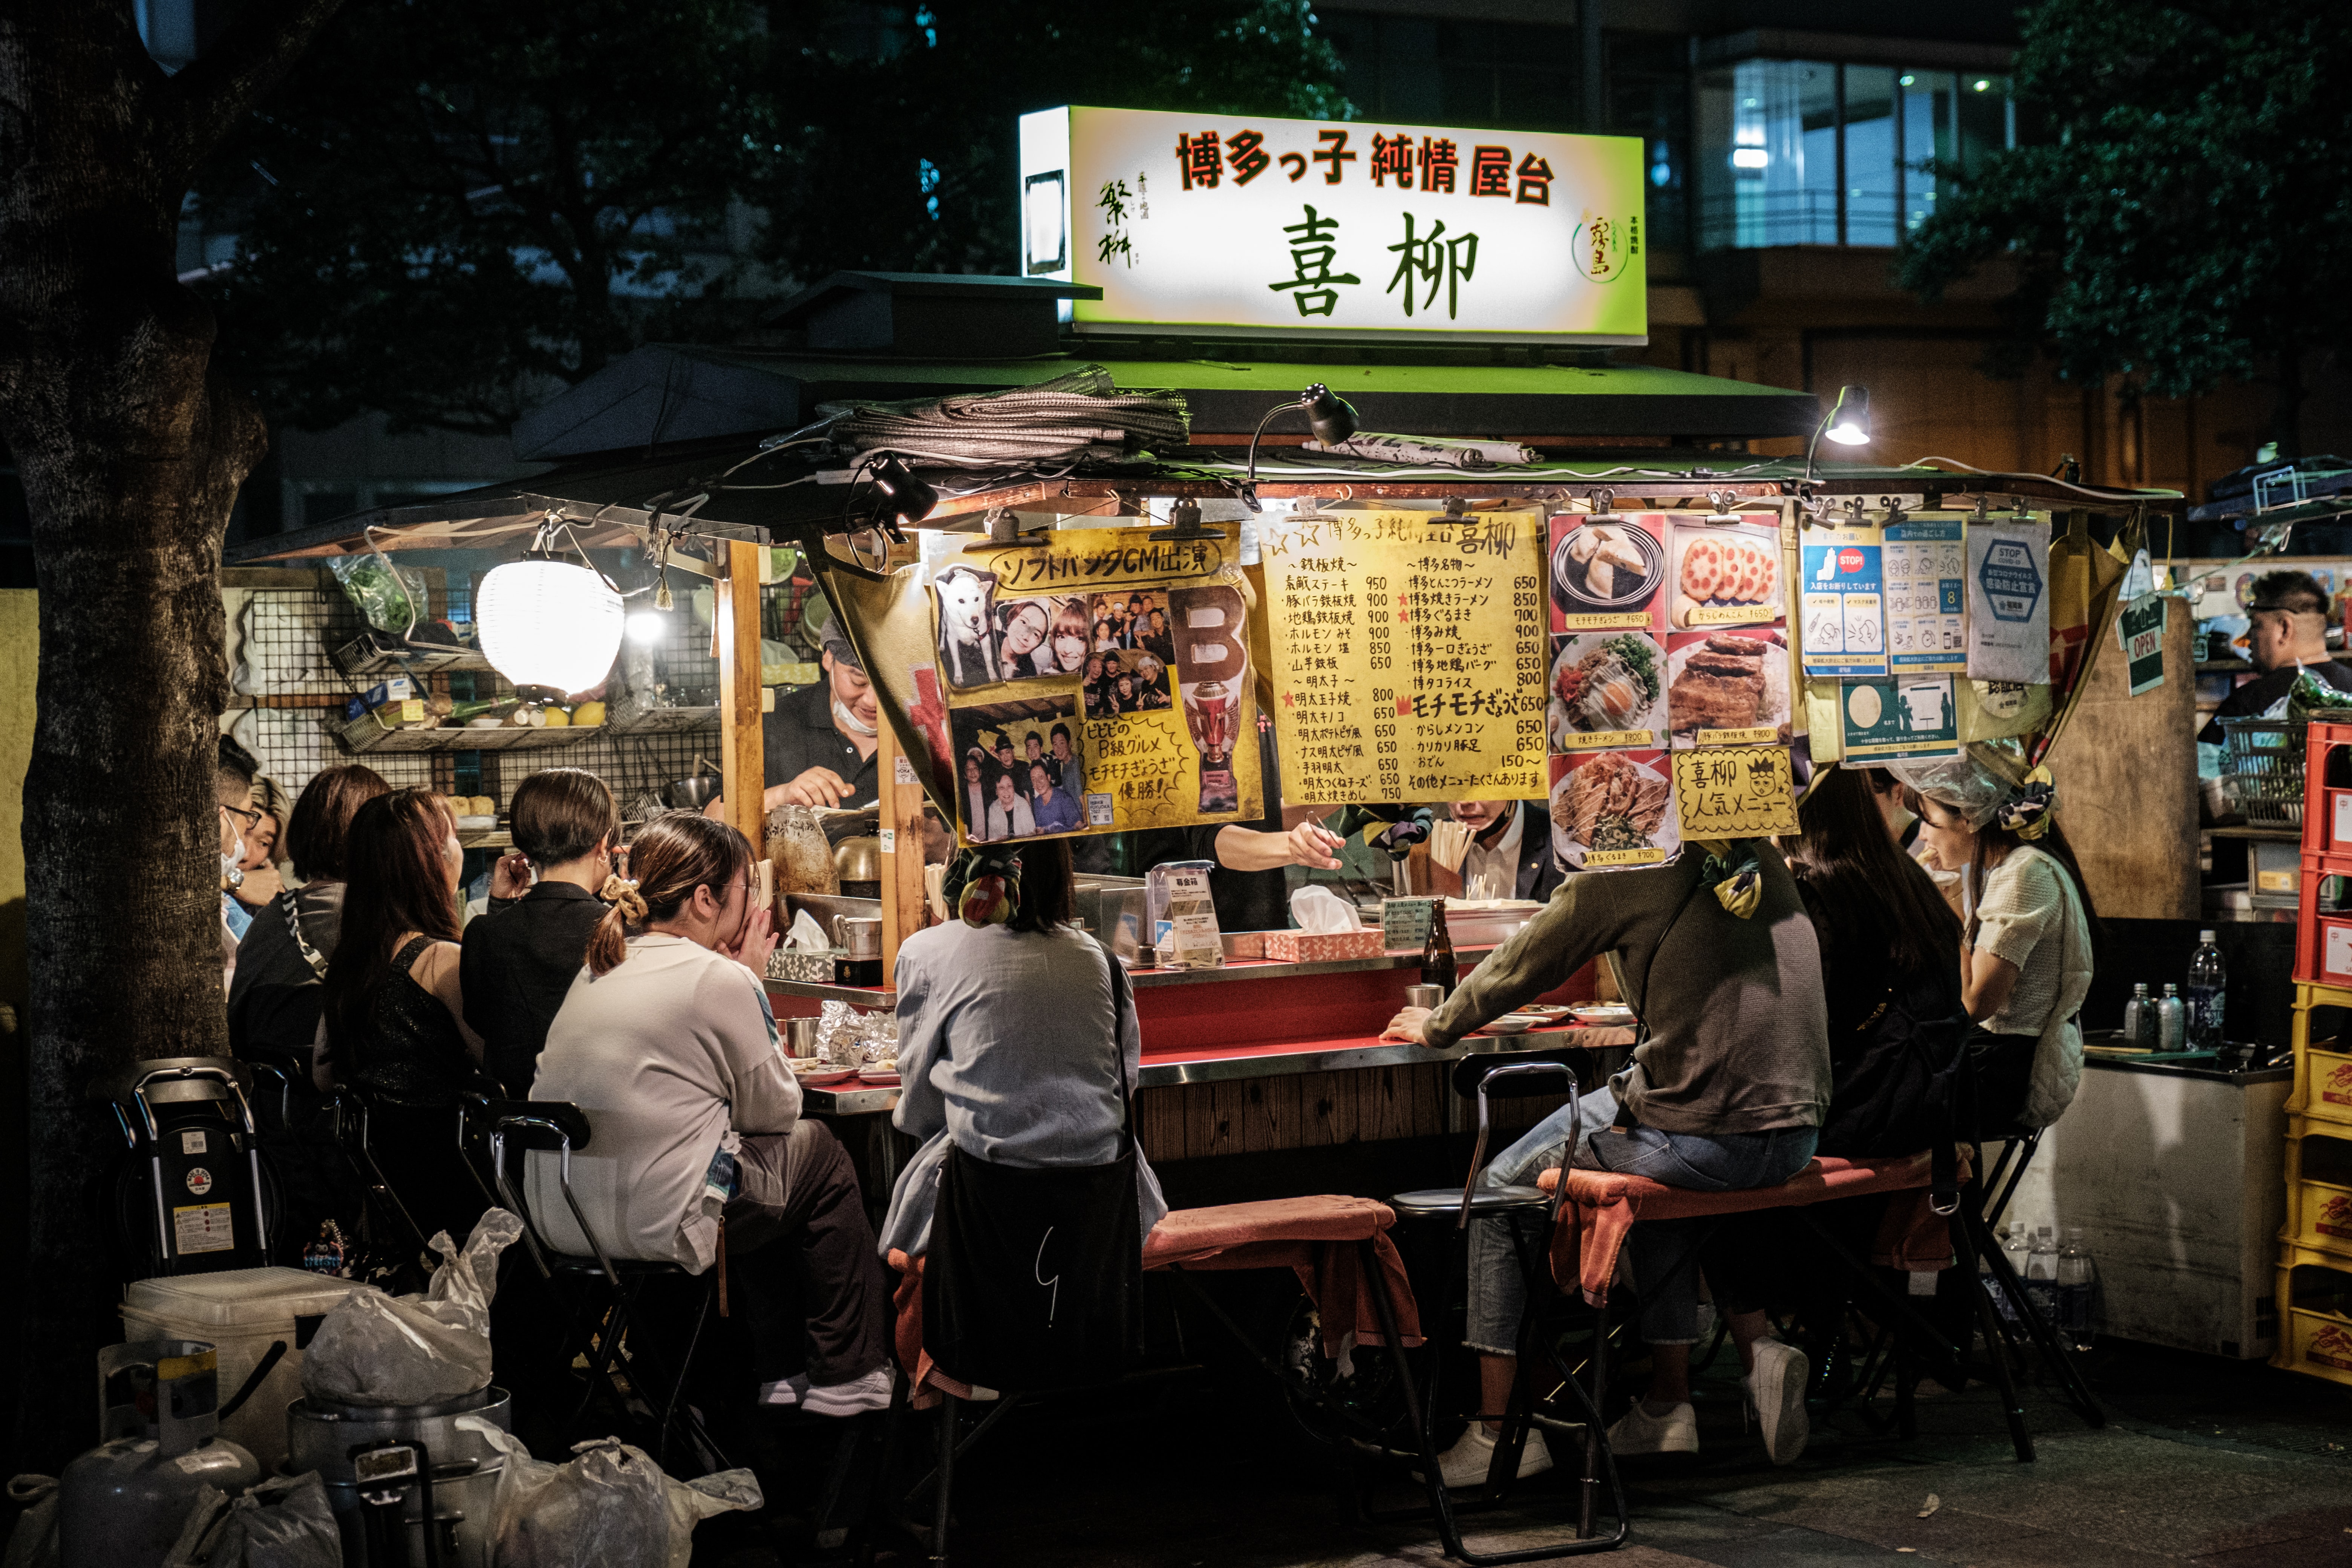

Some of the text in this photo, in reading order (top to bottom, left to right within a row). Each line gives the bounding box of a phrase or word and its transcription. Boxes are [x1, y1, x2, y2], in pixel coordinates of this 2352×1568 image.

[1176, 129, 1555, 207] 博多っ子 純情 屋台
[1269, 204, 1480, 320] 喜柳
[1004, 542, 1208, 584] ソフトバンクCM出演
[1840, 556, 1863, 565] STOP!
[1366, 576, 1387, 590] 950
[1409, 575, 1537, 590] 博多とんこつラーメン 650
[1810, 582, 1876, 590] 入店をお断りしています
[1286, 593, 1387, 608] 豚バラ鉄板焼 900
[1409, 592, 1537, 606] 博多焼きラーメン 850
[1948, 591, 1955, 604] 8
[1288, 609, 1388, 625] 地鶏鉄板焼 900
[1410, 607, 1538, 622] 博多ぐるまき 700
[1576, 615, 1644, 625] モチモチぎょうざ ¥650
[1699, 609, 1768, 620] からしめんこん ¥650
[1290, 627, 1389, 640] ホルモン みそ 900
[1411, 624, 1539, 640] 博多み焼 900
[1291, 642, 1390, 654] ホルモン 塩 850
[1516, 641, 1540, 654] 650
[2134, 631, 2156, 658] OPEN
[1292, 656, 1391, 671] 山芋鉄板 650
[1516, 657, 1541, 670] 650
[1517, 671, 1541, 686] 800
[1295, 688, 1393, 707] 明太玉子焼 800
[1412, 688, 1544, 718] モチモチぎょうざ 650
[1297, 707, 1395, 724] 明太キノコ 650
[1087, 721, 1130, 739] ビビビの
[1298, 724, 1395, 742] 明太ポテトピザ風 650
[1417, 720, 1542, 736] からしメンコン 650
[1417, 737, 1544, 752] カリカリ豚足 650
[1579, 733, 1642, 744] 焼きラーメン ¥900
[1099, 734, 1162, 759] B級グルメ
[1301, 741, 1397, 759] ナス明太ピザ風 650
[1089, 757, 1175, 781] モチモチぎょうざ
[1302, 758, 1398, 775] 手羽明太 650
[1418, 755, 1444, 768] おでん
[1303, 773, 1400, 790] 明太つくねチーズ 650
[1409, 771, 1539, 790] その他メニューたくさんあります
[1690, 760, 1736, 789] 喜柳
[1305, 787, 1401, 803] 明太焼きめし 750
[1694, 792, 1786, 818] 人気メニュー
[1637, 851, 1654, 859] ¥700
[1176, 878, 1198, 886] 募金箱
